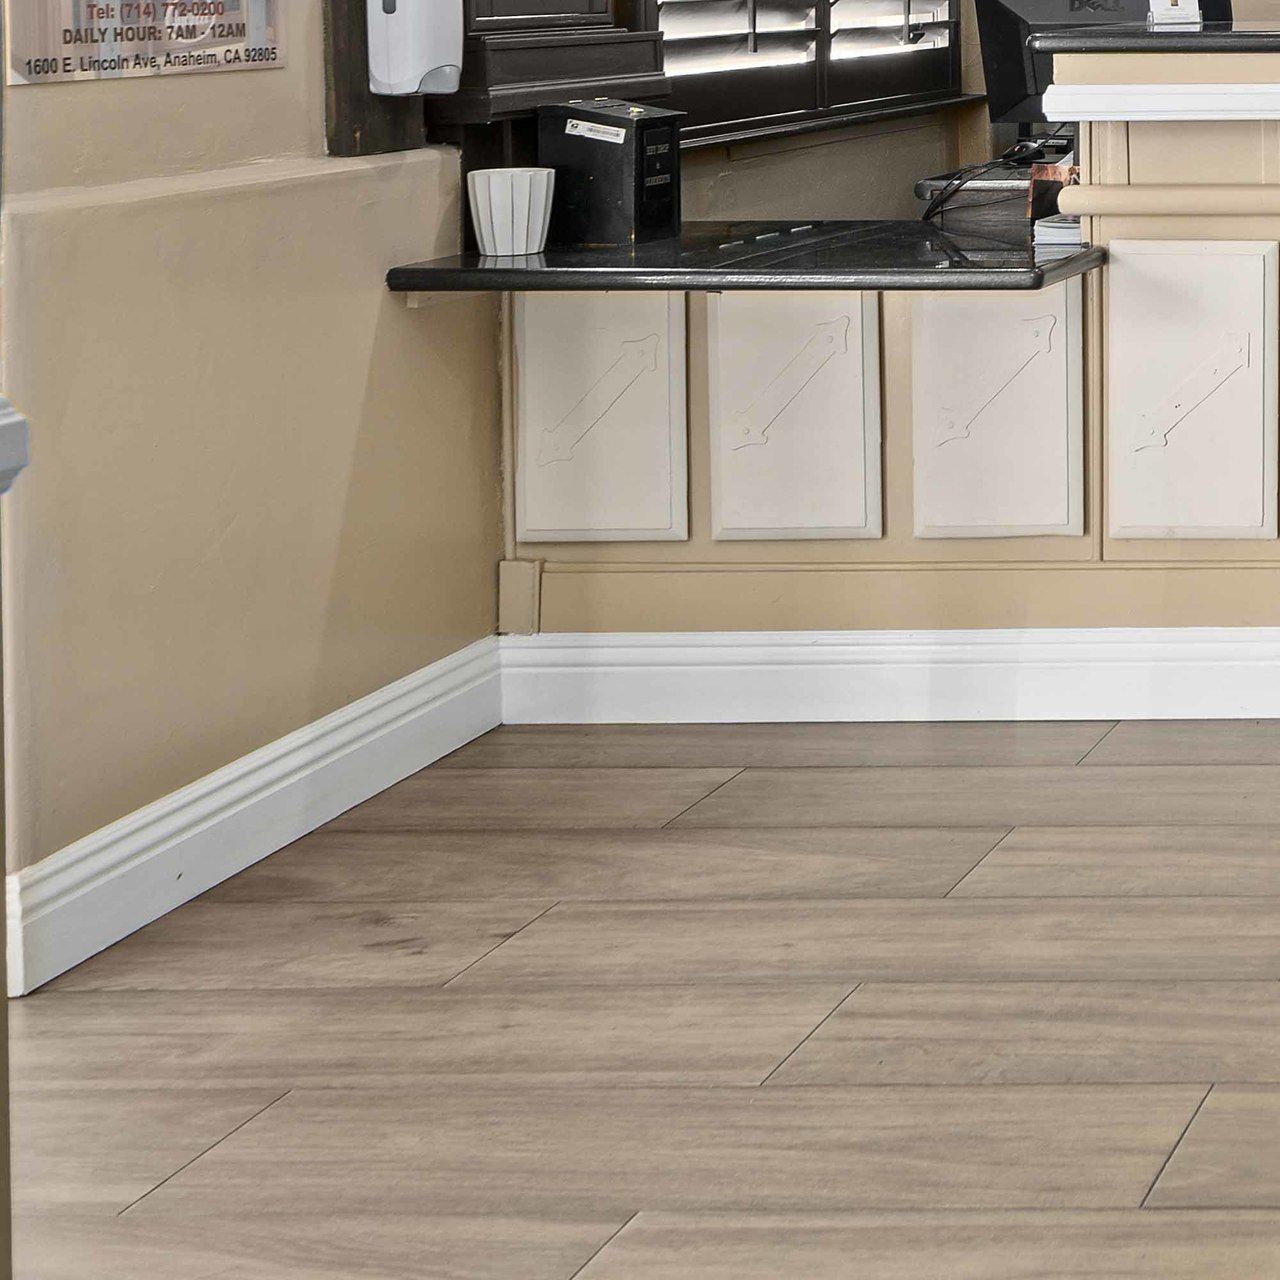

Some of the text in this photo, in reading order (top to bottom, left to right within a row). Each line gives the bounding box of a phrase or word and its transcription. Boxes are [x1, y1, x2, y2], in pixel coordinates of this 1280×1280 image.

[87, 2, 224, 22] Tel: (714) 772-0200
[63, 27, 107, 45] DAILY
[113, 26, 162, 43] HOUR:
[167, 25, 196, 40] 7AM
[210, 23, 246, 38] 12AM
[26, 47, 277, 76] 1600 E. Lincoln Ave, Anaheim, CA 92805
